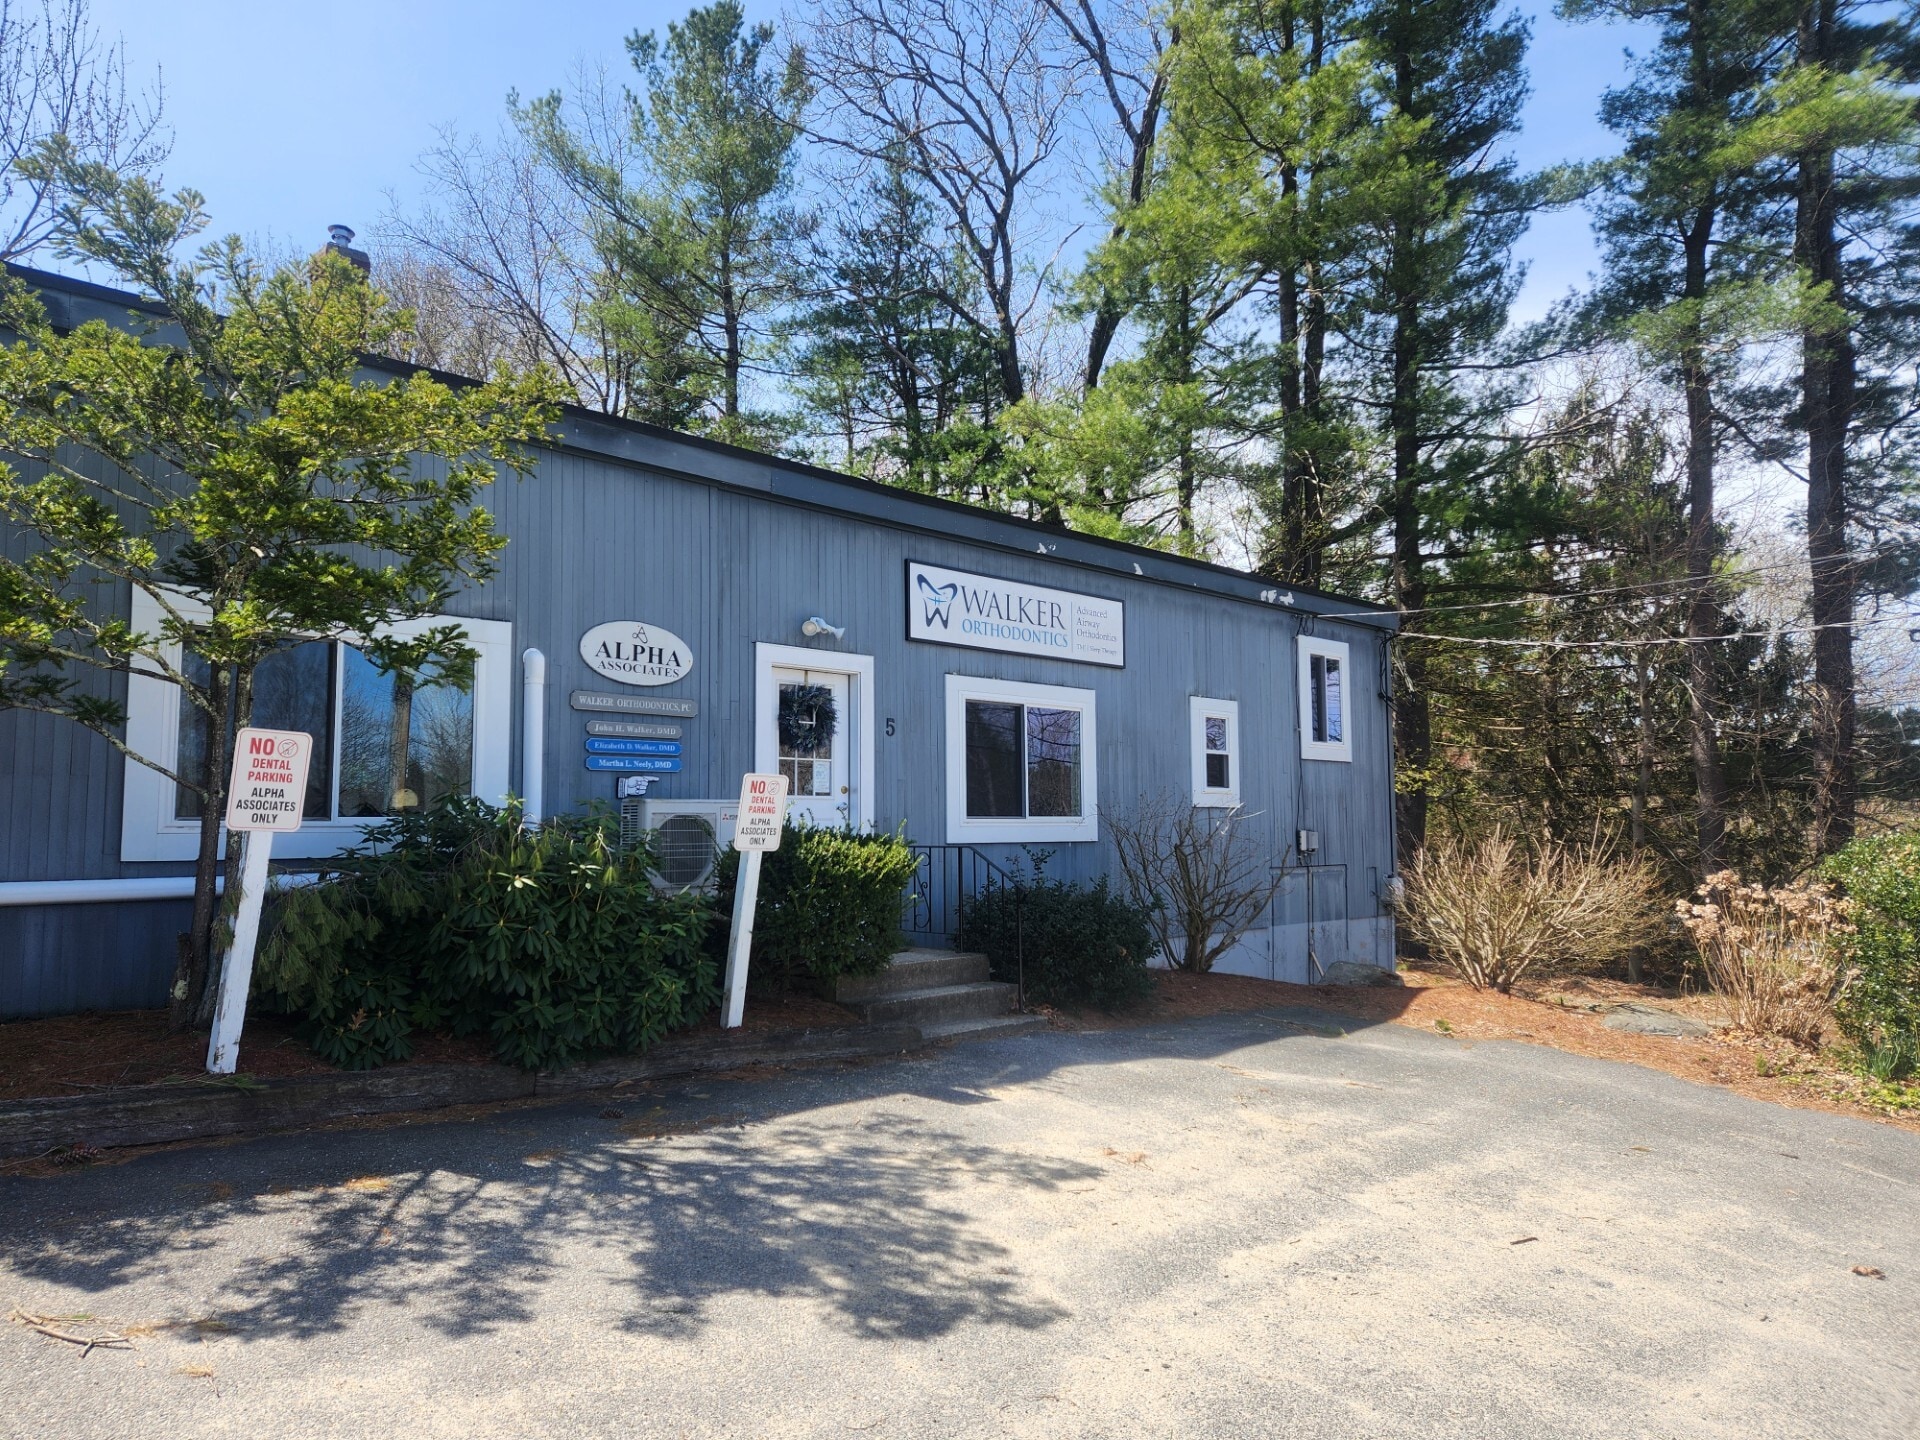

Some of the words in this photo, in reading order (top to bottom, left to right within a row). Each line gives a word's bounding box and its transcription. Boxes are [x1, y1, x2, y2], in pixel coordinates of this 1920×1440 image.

[961, 585, 1065, 630] WALKER
[1076, 605, 1108, 619] Advanced
[1076, 617, 1101, 630] Airway
[962, 618, 1069, 648] ORTHODONTICS
[1076, 628, 1118, 642] Orthodontics
[595, 640, 681, 667] ALPHA
[597, 660, 680, 678] ASSOCIATES
[578, 695, 614, 707] WALKER
[616, 698, 680, 712] ORTHODONTICS,
[681, 702, 692, 712] PC
[595, 723, 613, 732] John
[615, 725, 625, 733] H.
[627, 725, 655, 735] Walker,
[657, 727, 676, 735] DMD
[885, 717, 896, 737] 5
[249, 737, 275, 755] NO
[594, 741, 625, 750] Elizabeth
[626, 742, 633, 750] D.
[634, 743, 658, 752] Walker,
[658, 744, 676, 752] DMD
[252, 758, 291, 770] DENTAL
[598, 759, 624, 768] Martha
[625, 760, 632, 768] L.
[633, 760, 654, 770] Neely,
[654, 761, 672, 769] DMD
[248, 771, 293, 783] PARKING
[251, 787, 285, 798] ALPHA
[750, 781, 766, 794] NO
[236, 800, 296, 811] ASSOCIATES
[751, 796, 775, 805] DENTAL
[748, 806, 776, 815] PARKING
[251, 813, 278, 823] ONLY
[750, 818, 770, 826] ALPHA
[740, 827, 777, 836] ASSOCIATES
[749, 837, 766, 845] ONLY
